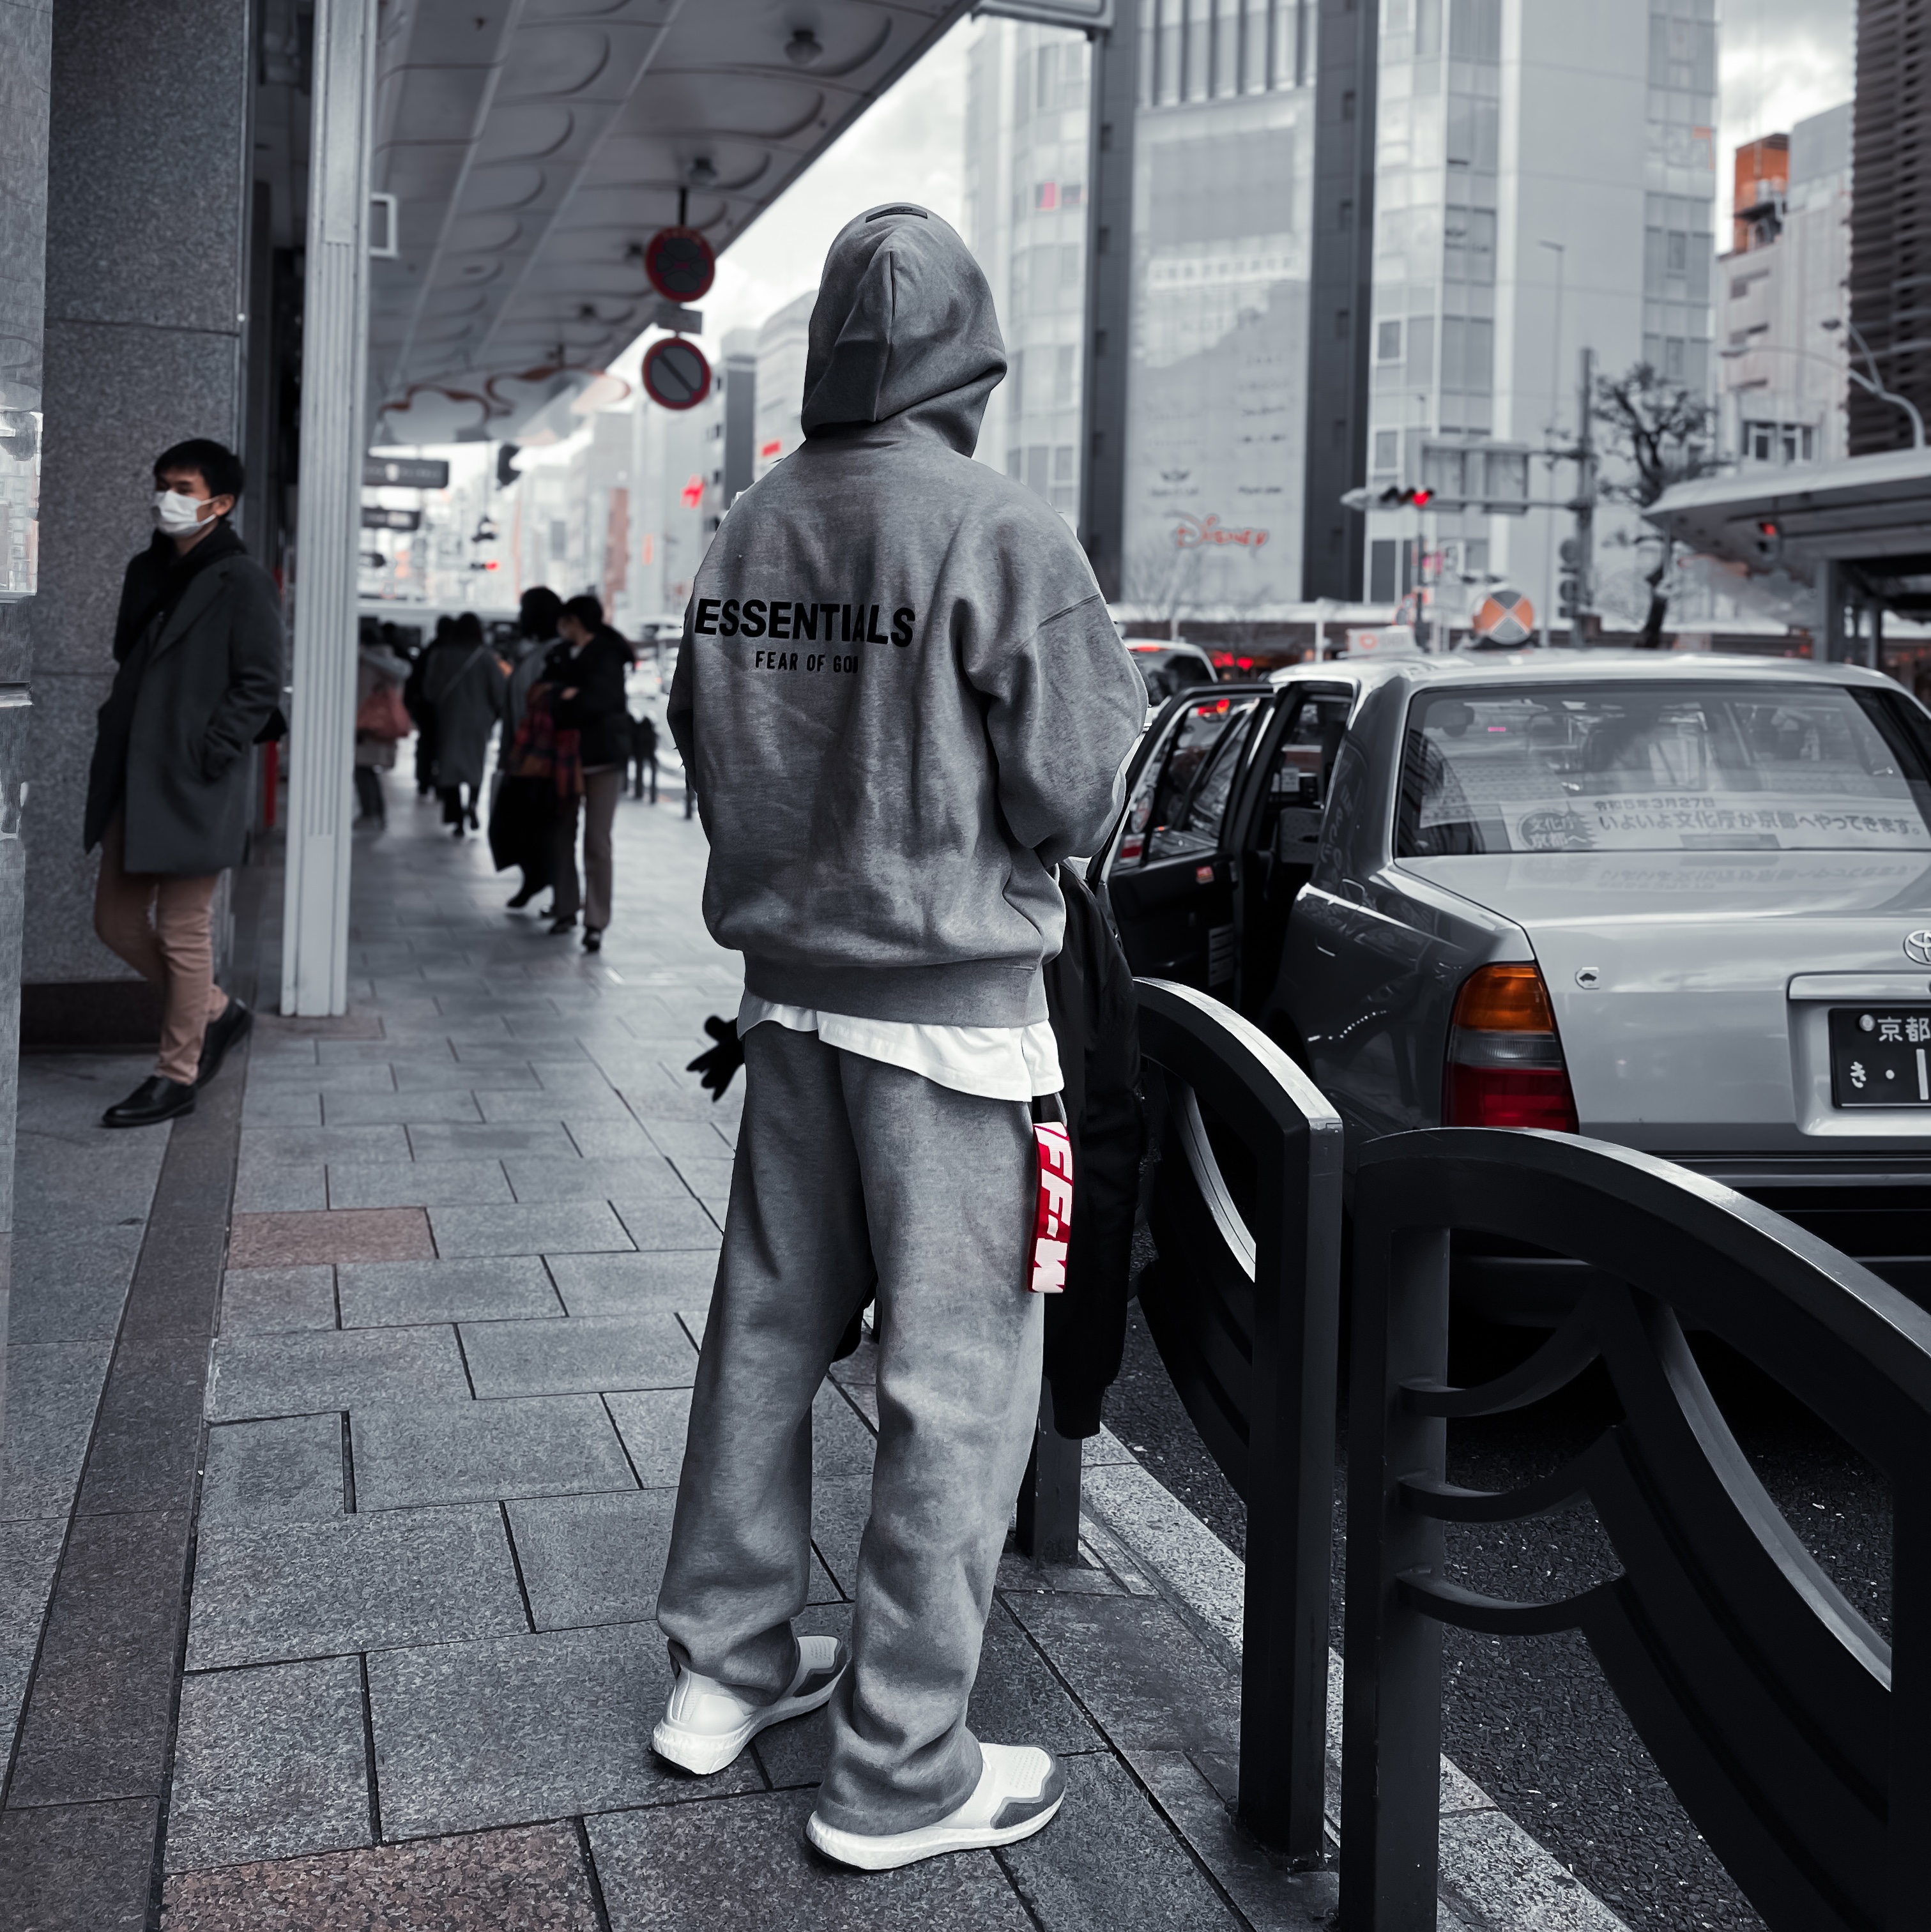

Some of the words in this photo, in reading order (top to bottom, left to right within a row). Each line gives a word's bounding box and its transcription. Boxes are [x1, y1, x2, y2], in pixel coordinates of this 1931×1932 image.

[694, 598, 915, 648] ESSENTIALS
[756, 650, 797, 671] FEAR
[806, 653, 825, 671] OF
[1877, 1015, 1931, 1042] 京都
